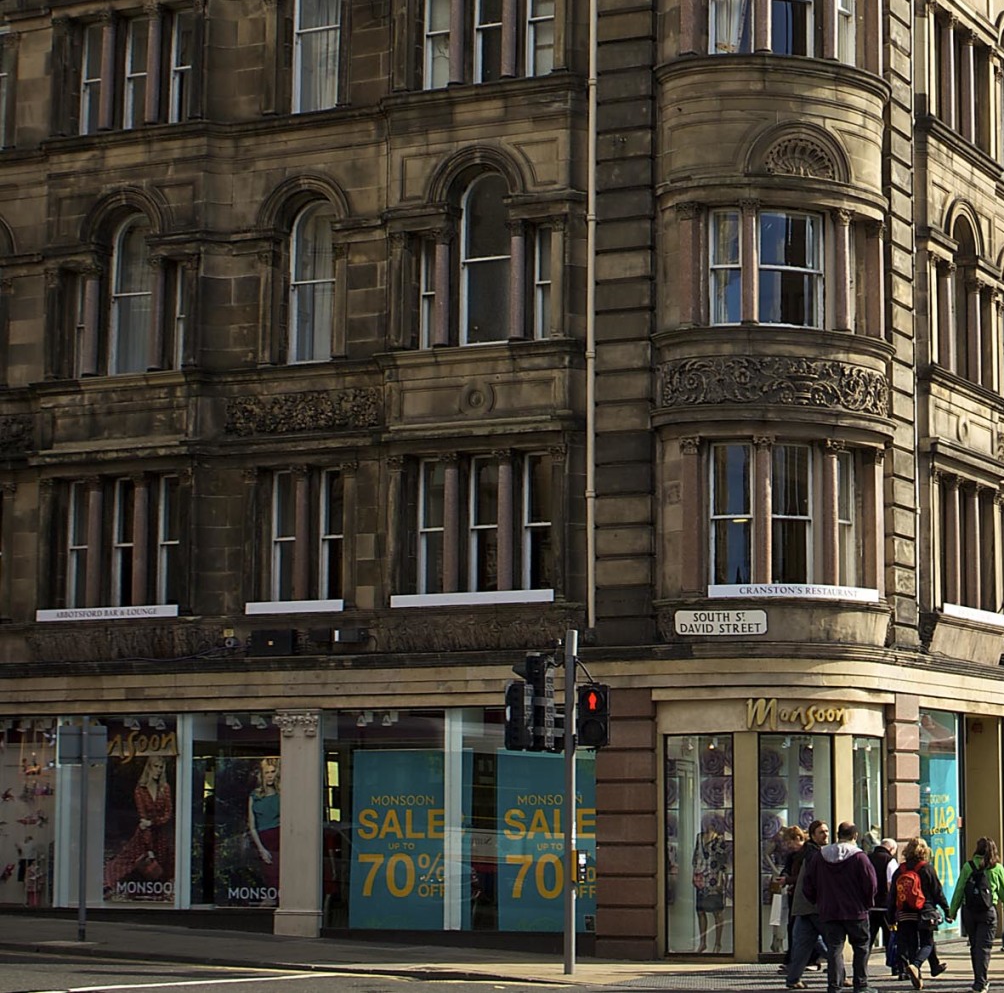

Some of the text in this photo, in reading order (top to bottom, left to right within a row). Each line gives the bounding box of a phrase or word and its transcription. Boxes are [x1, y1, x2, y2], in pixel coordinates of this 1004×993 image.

[739, 585, 858, 598] CRANSTON'S RESTAURANT
[55, 610, 103, 619] ABBOTSFORD
[104, 609, 118, 617] BAR
[126, 607, 158, 616] LOUNGE
[693, 612, 730, 622] SOUTH
[680, 623, 762, 633] DAVID STREET
[746, 698, 846, 732] Monsoon
[107, 731, 178, 764] nsoon
[371, 795, 435, 806] MONSOON
[517, 794, 583, 805] MONSON
[357, 808, 446, 840] SALE
[504, 808, 596, 840] SALE
[537, 843, 548, 851] UP
[116, 881, 174, 894] MONSOO
[227, 887, 280, 900] MONSO
[575, 885, 596, 899] FF
